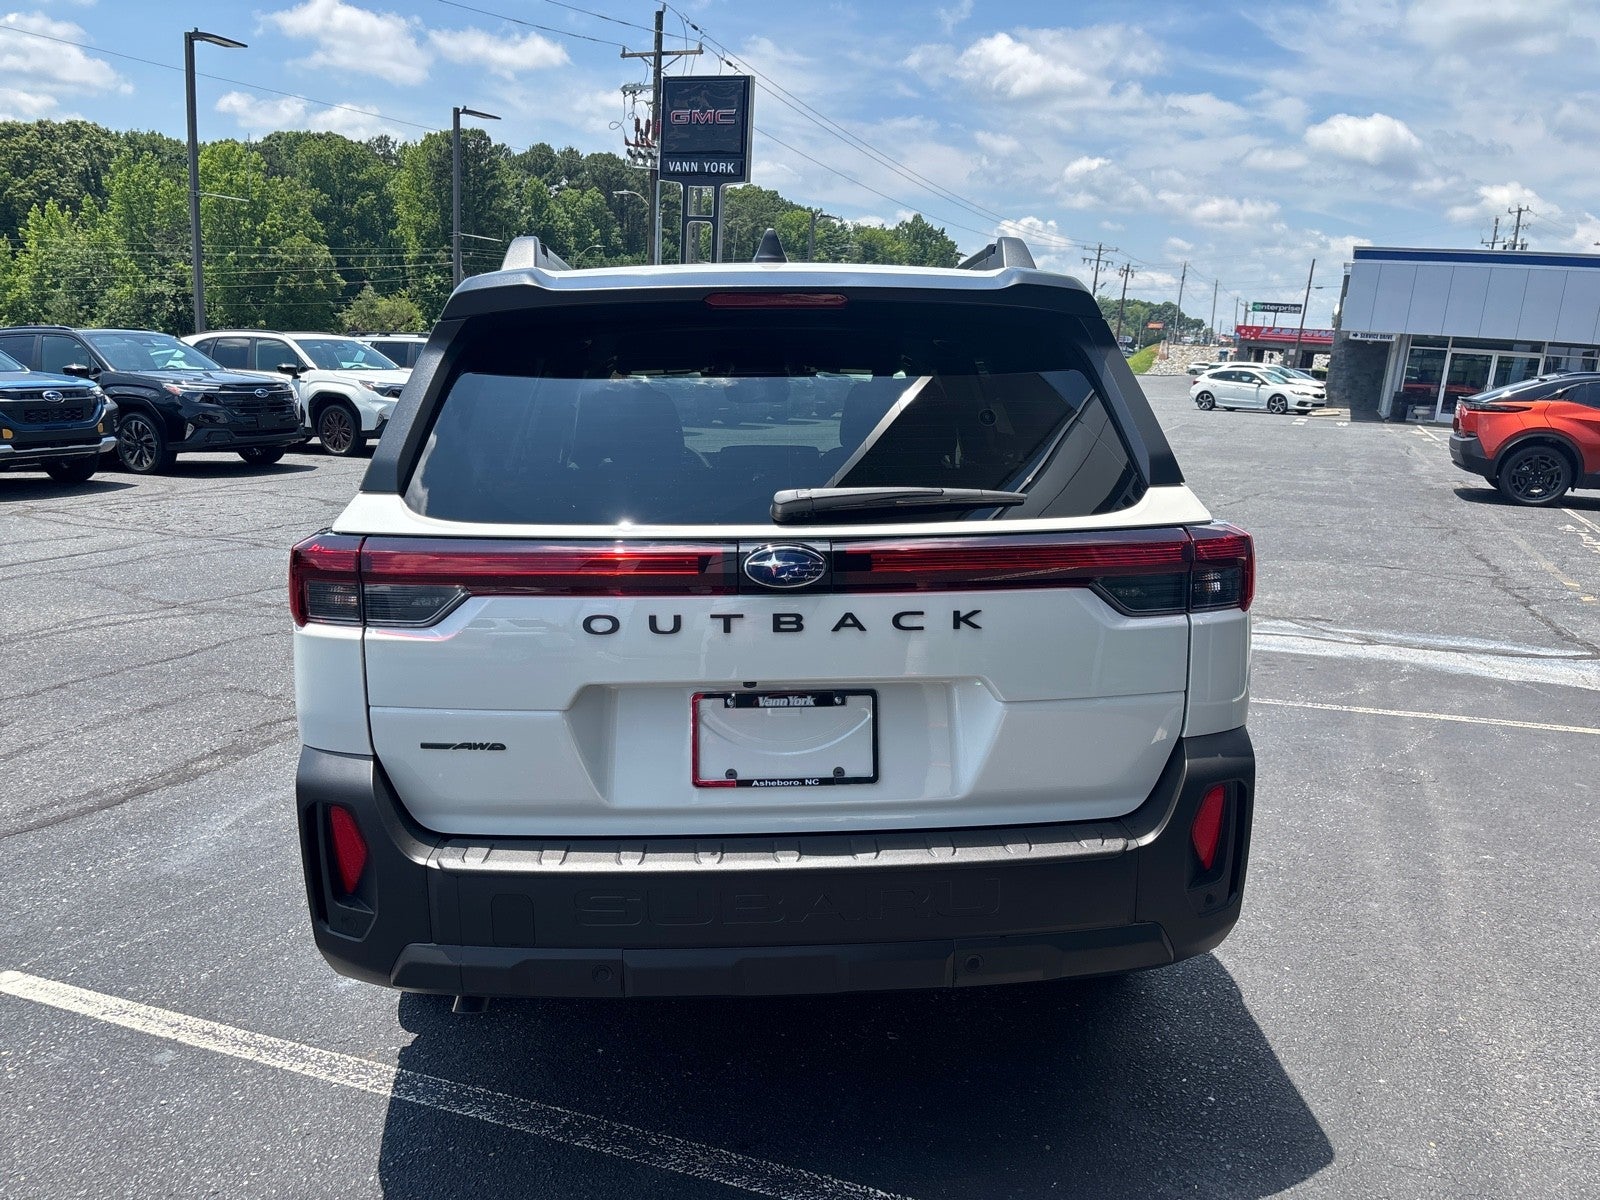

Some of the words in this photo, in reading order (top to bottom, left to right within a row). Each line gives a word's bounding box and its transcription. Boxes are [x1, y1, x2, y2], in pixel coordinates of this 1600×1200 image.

[671, 109, 736, 125] GMC
[668, 161, 698, 172] VANN
[703, 162, 735, 174] YORK
[1253, 303, 1301, 312] enterprise
[1360, 332, 1379, 340] SERVICE
[1379, 333, 1394, 341] DRIVE
[582, 609, 983, 635] OUTBACK
[452, 742, 507, 751] AWD
[805, 778, 820, 786] NC
[574, 878, 1000, 927] SUBARU
